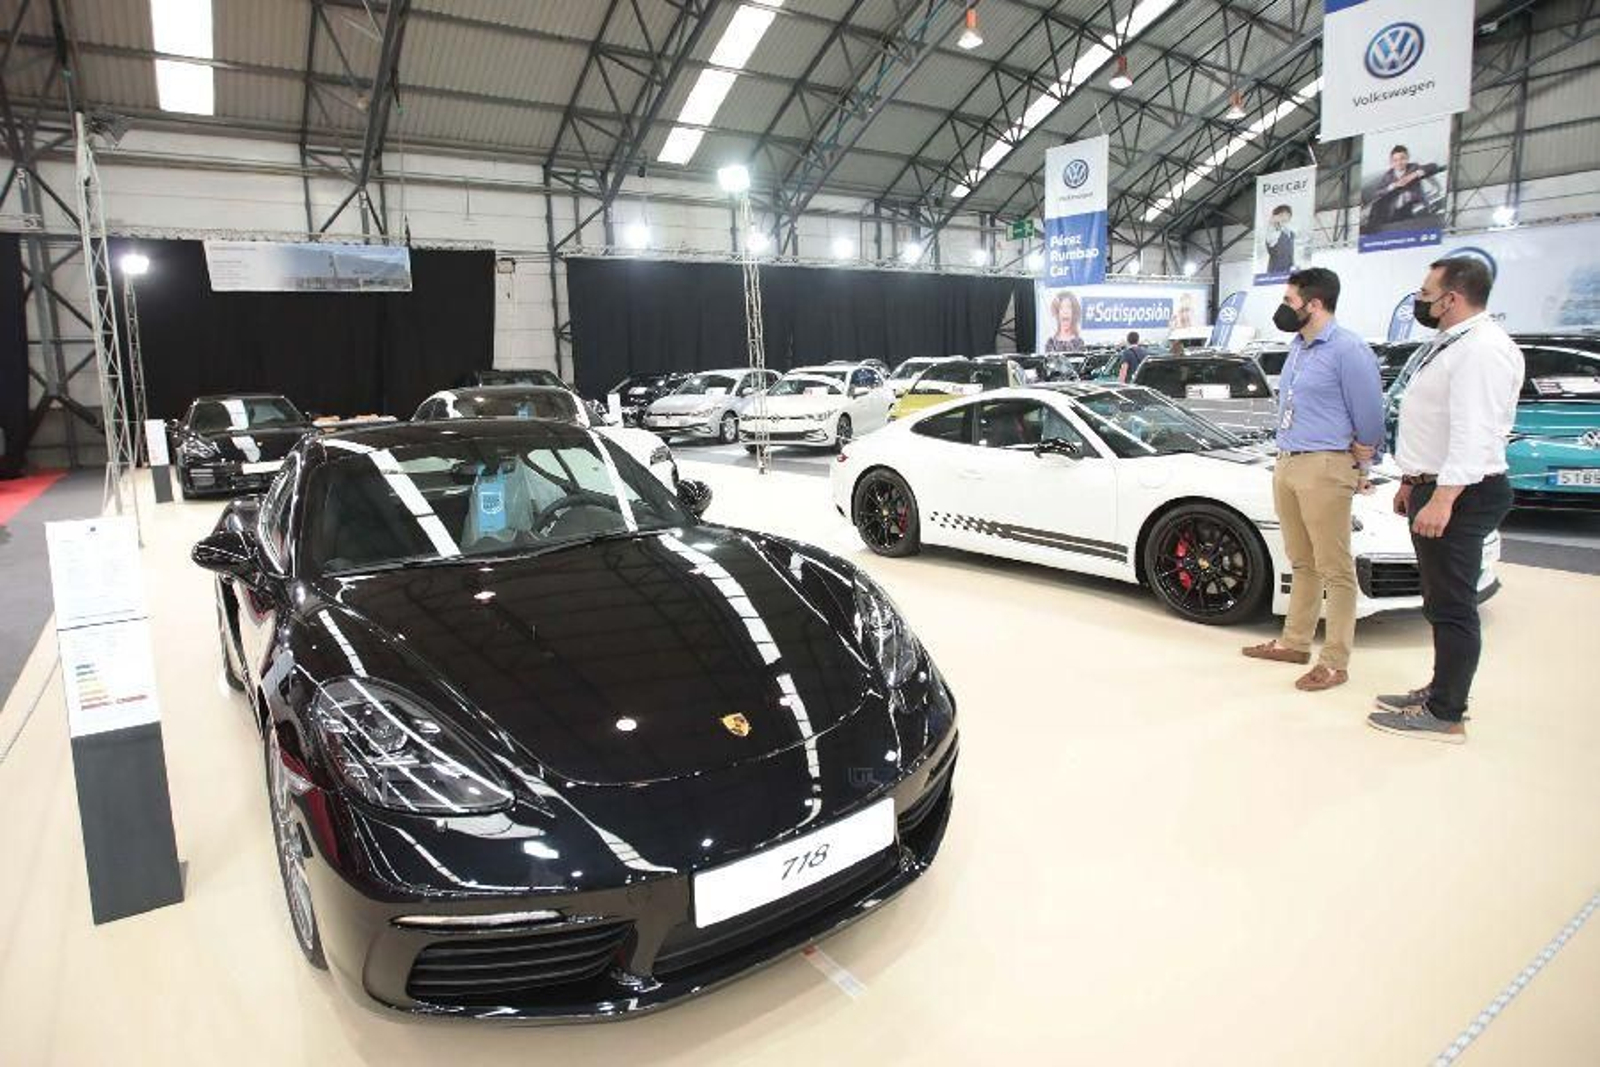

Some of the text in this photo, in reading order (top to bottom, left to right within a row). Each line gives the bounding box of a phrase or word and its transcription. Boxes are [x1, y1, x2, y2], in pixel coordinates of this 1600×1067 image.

[1352, 79, 1436, 108] Volkswagen
[1262, 178, 1309, 195] Percar
[1050, 233, 1082, 248] Pérez
[1050, 247, 1100, 262] Rumbao
[1049, 265, 1071, 278] Car
[1085, 301, 1171, 326] #Satisposión
[781, 843, 830, 881] 718
